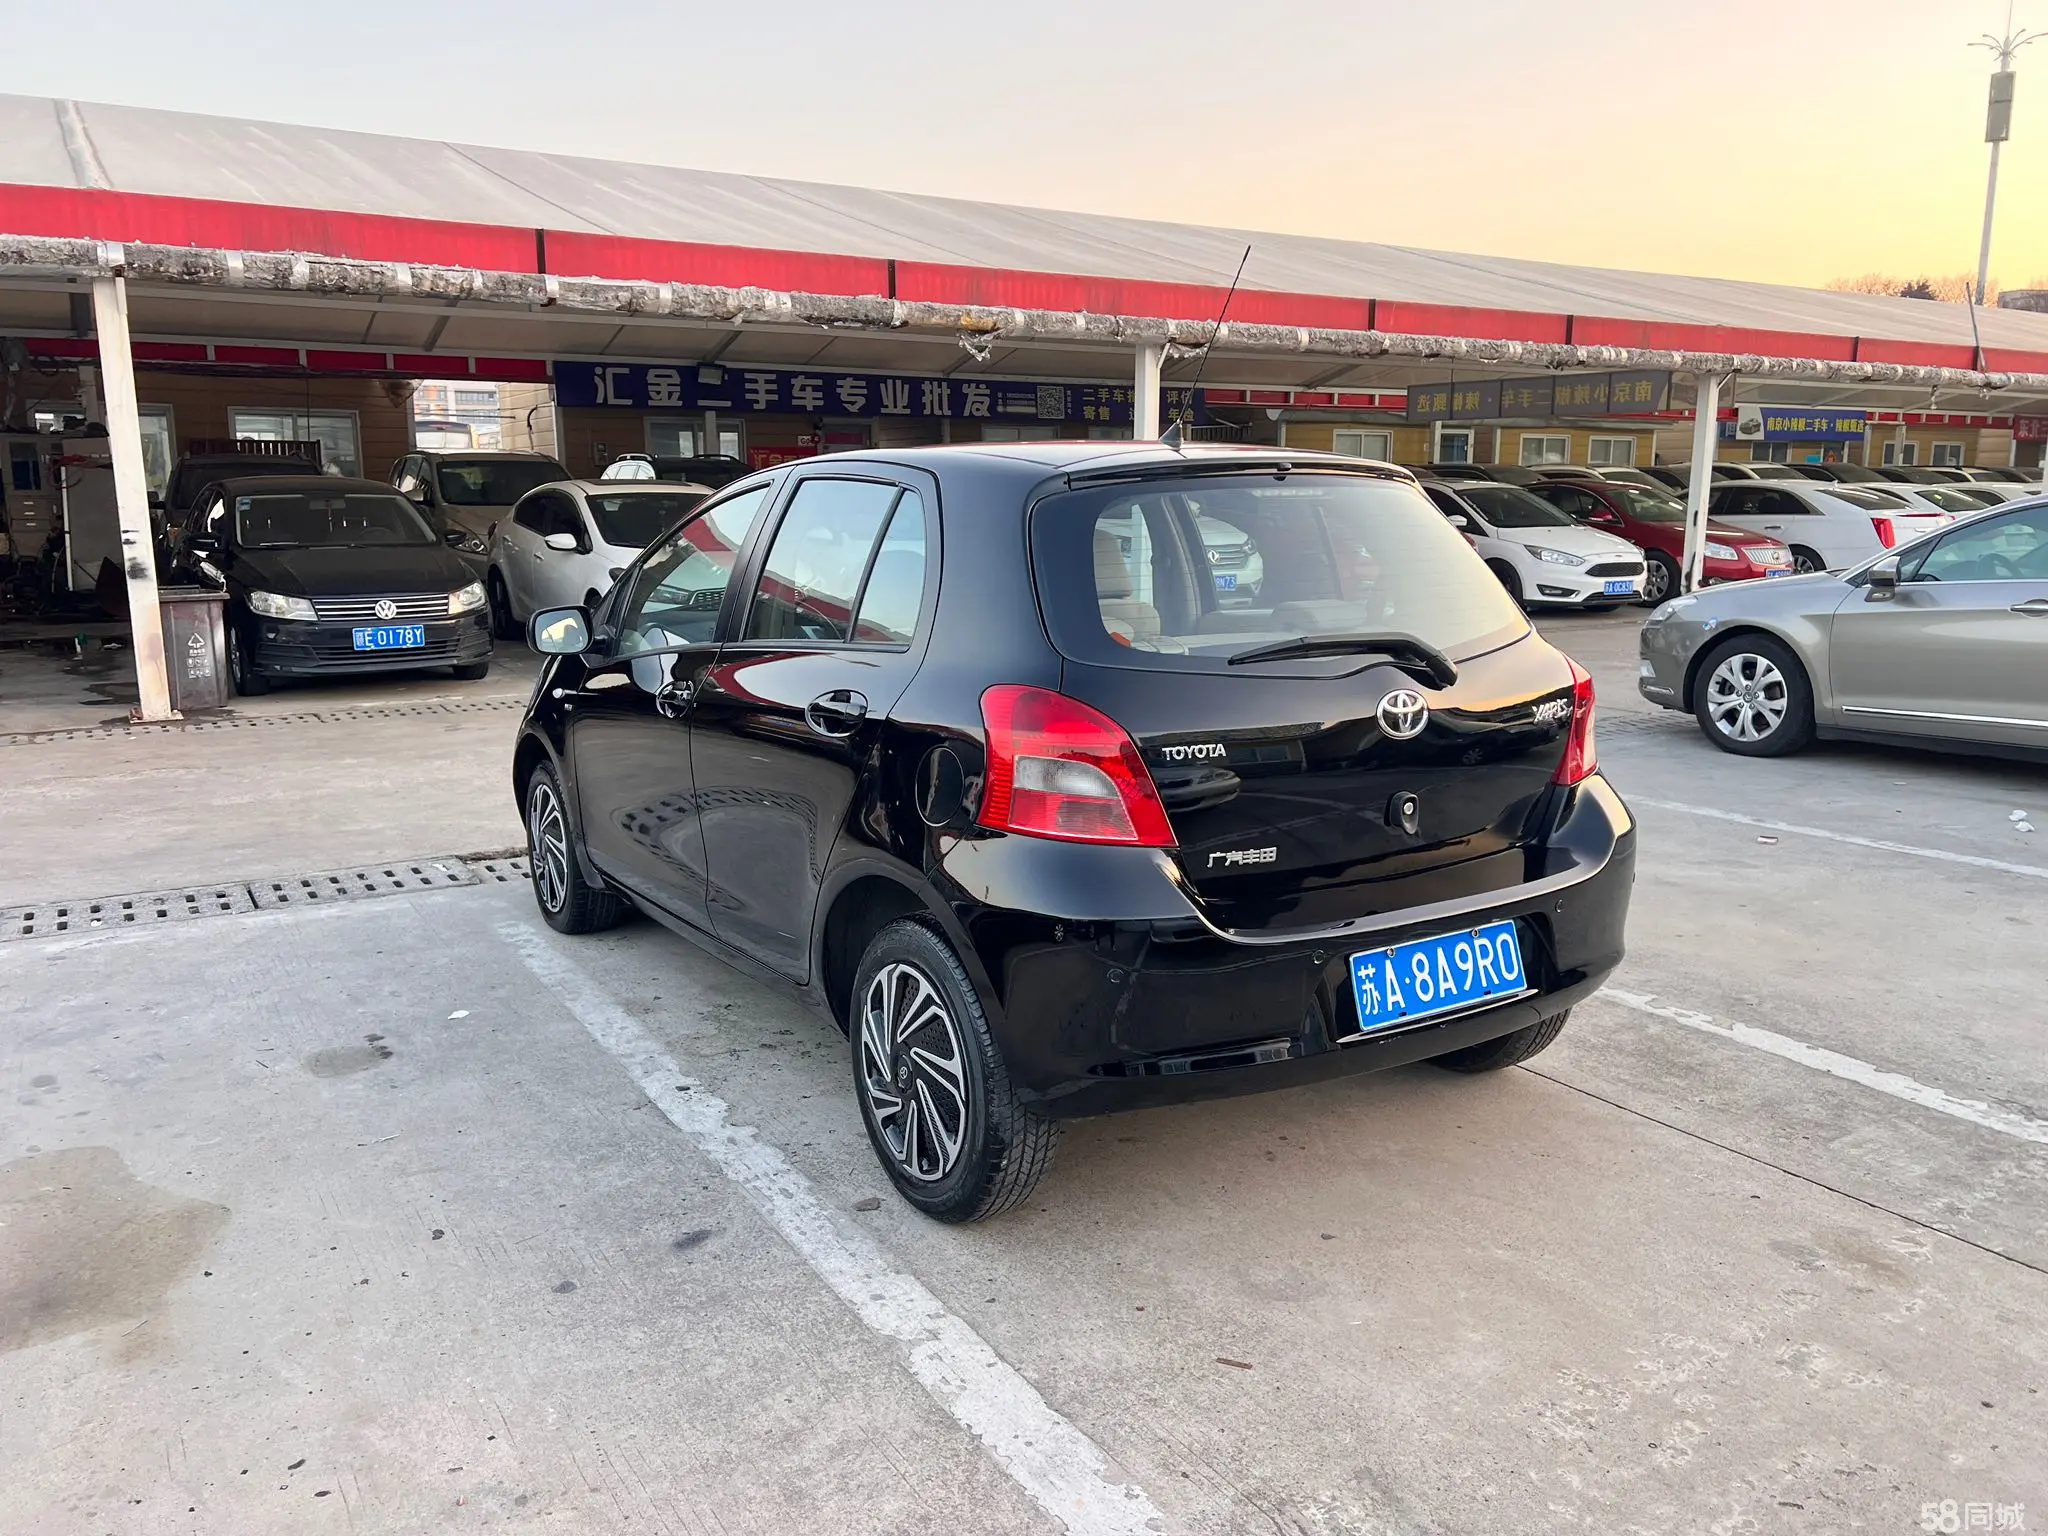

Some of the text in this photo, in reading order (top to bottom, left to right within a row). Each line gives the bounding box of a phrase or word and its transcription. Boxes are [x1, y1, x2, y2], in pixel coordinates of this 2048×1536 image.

[1162, 744, 1226, 760] TOYOTA
[1206, 847, 1277, 868] 广汽丰田
